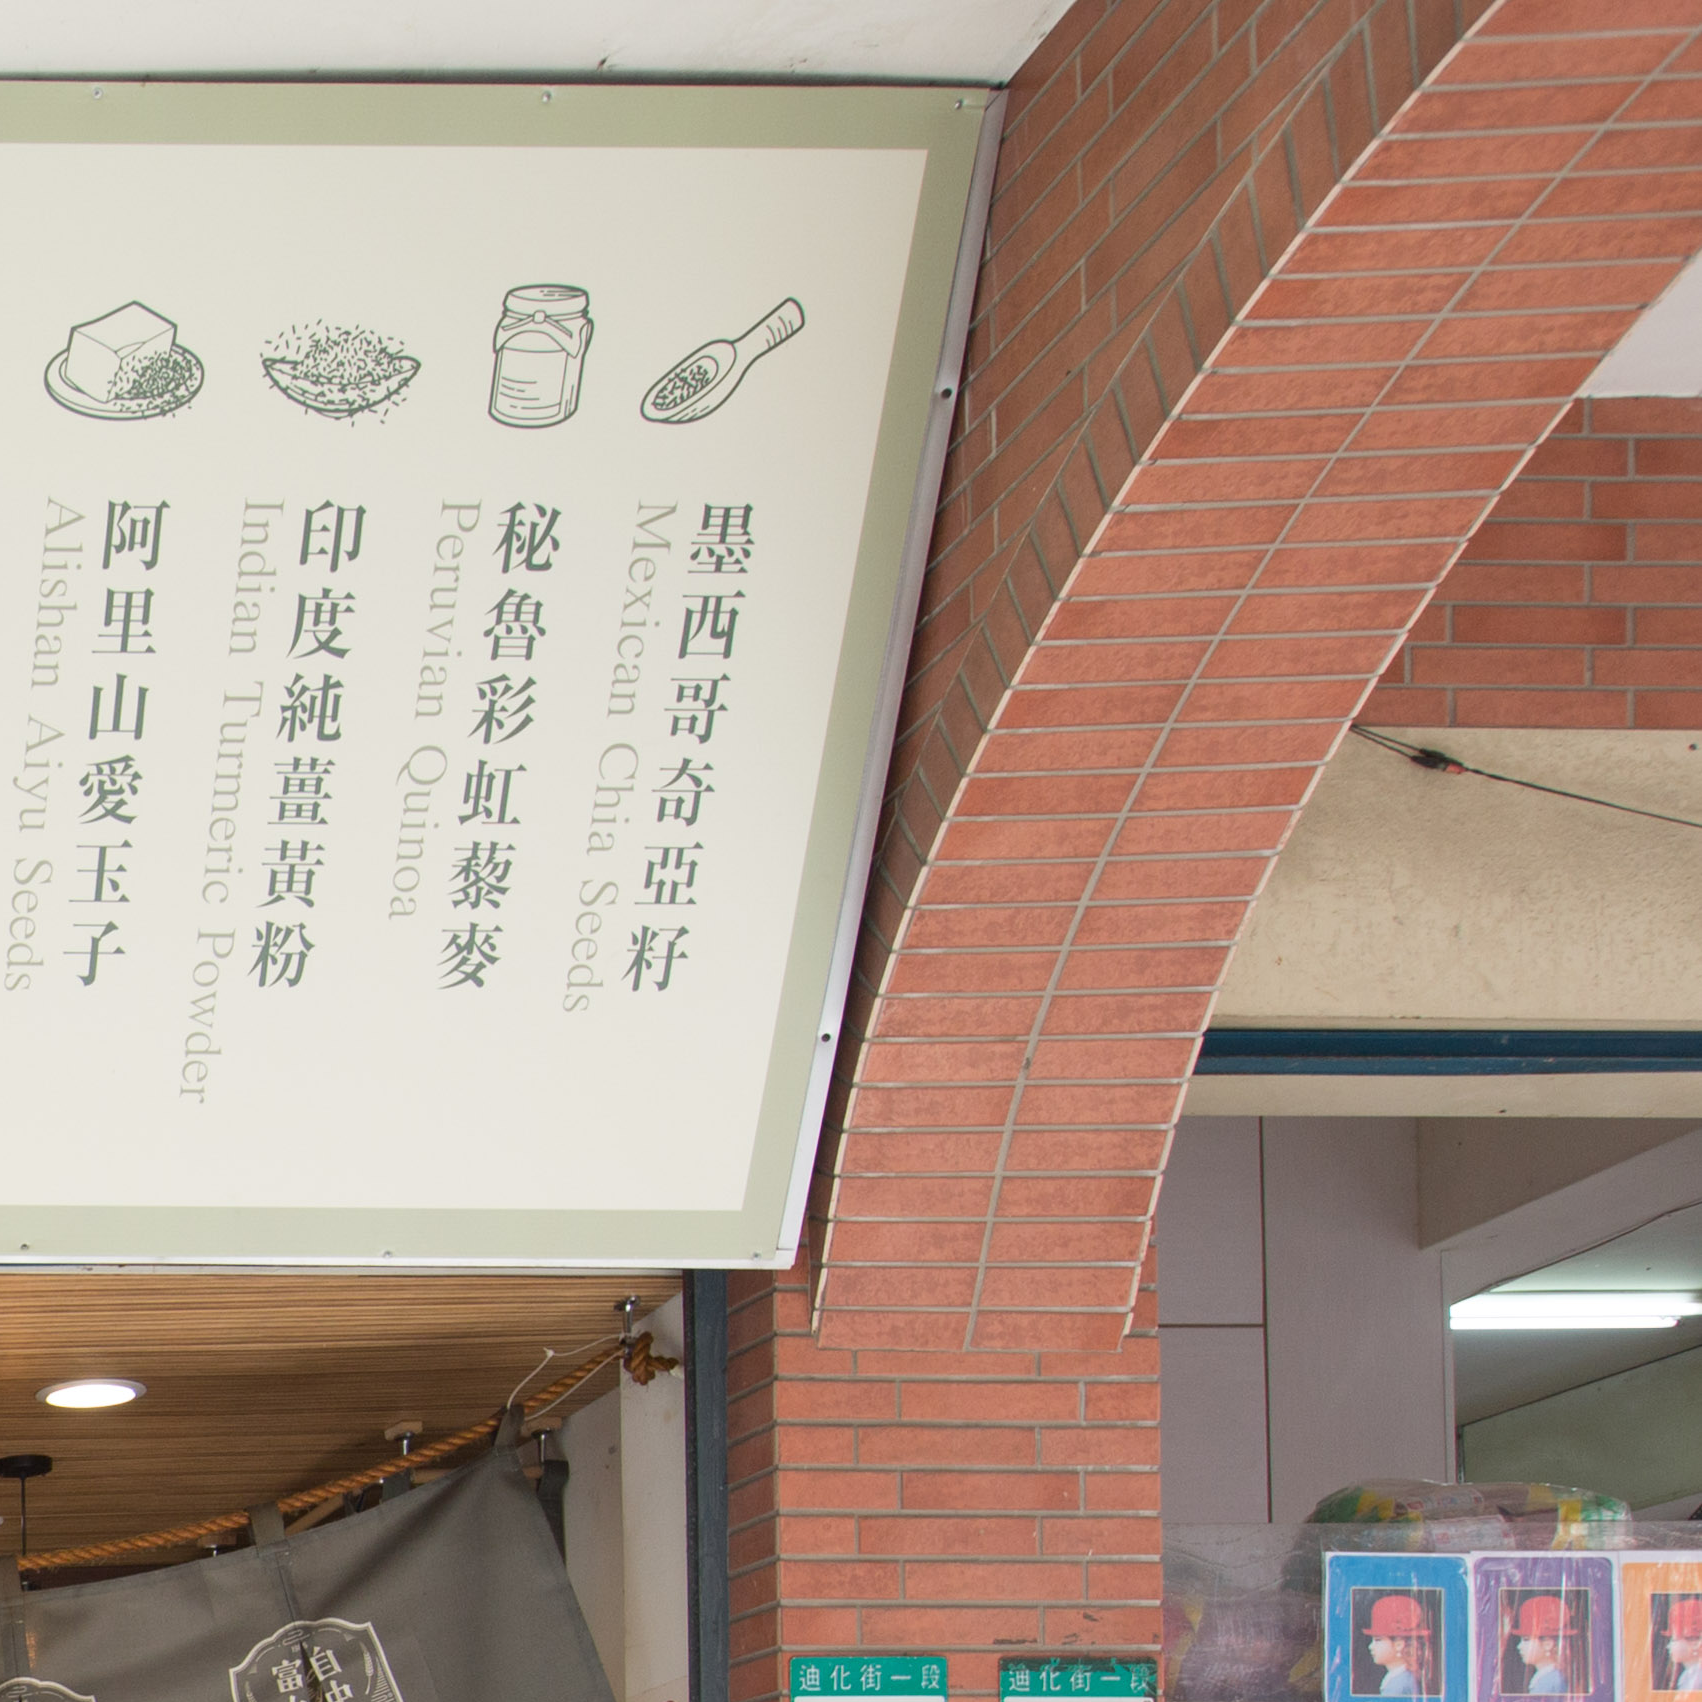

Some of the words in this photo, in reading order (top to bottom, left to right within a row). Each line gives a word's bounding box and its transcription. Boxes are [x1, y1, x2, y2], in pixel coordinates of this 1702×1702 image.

[31, 496, 86, 688] Alishan
[229, 498, 285, 656] Indian
[414, 498, 481, 719] Peruvian
[607, 500, 678, 718] Mexican
[13, 714, 65, 832] Aiyu
[63, 499, 170, 986] 阿里山愛玉子
[202, 681, 264, 904] Turmeric
[248, 500, 366, 987] 印度純薑黃粉
[437, 502, 561, 990] 秘魯彩虹藜麥
[586, 743, 639, 856] Chia
[621, 503, 754, 991] 墨西哥奇亞籽
[389, 745, 448, 920] Quinoa
[3, 858, 53, 992] Seeds
[563, 879, 618, 1012] Seeds
[180, 928, 236, 1103] Powder
[799, 1664, 940, 1691] 迪化街一段
[1009, 1664, 1147, 1692] 迪化街一段
